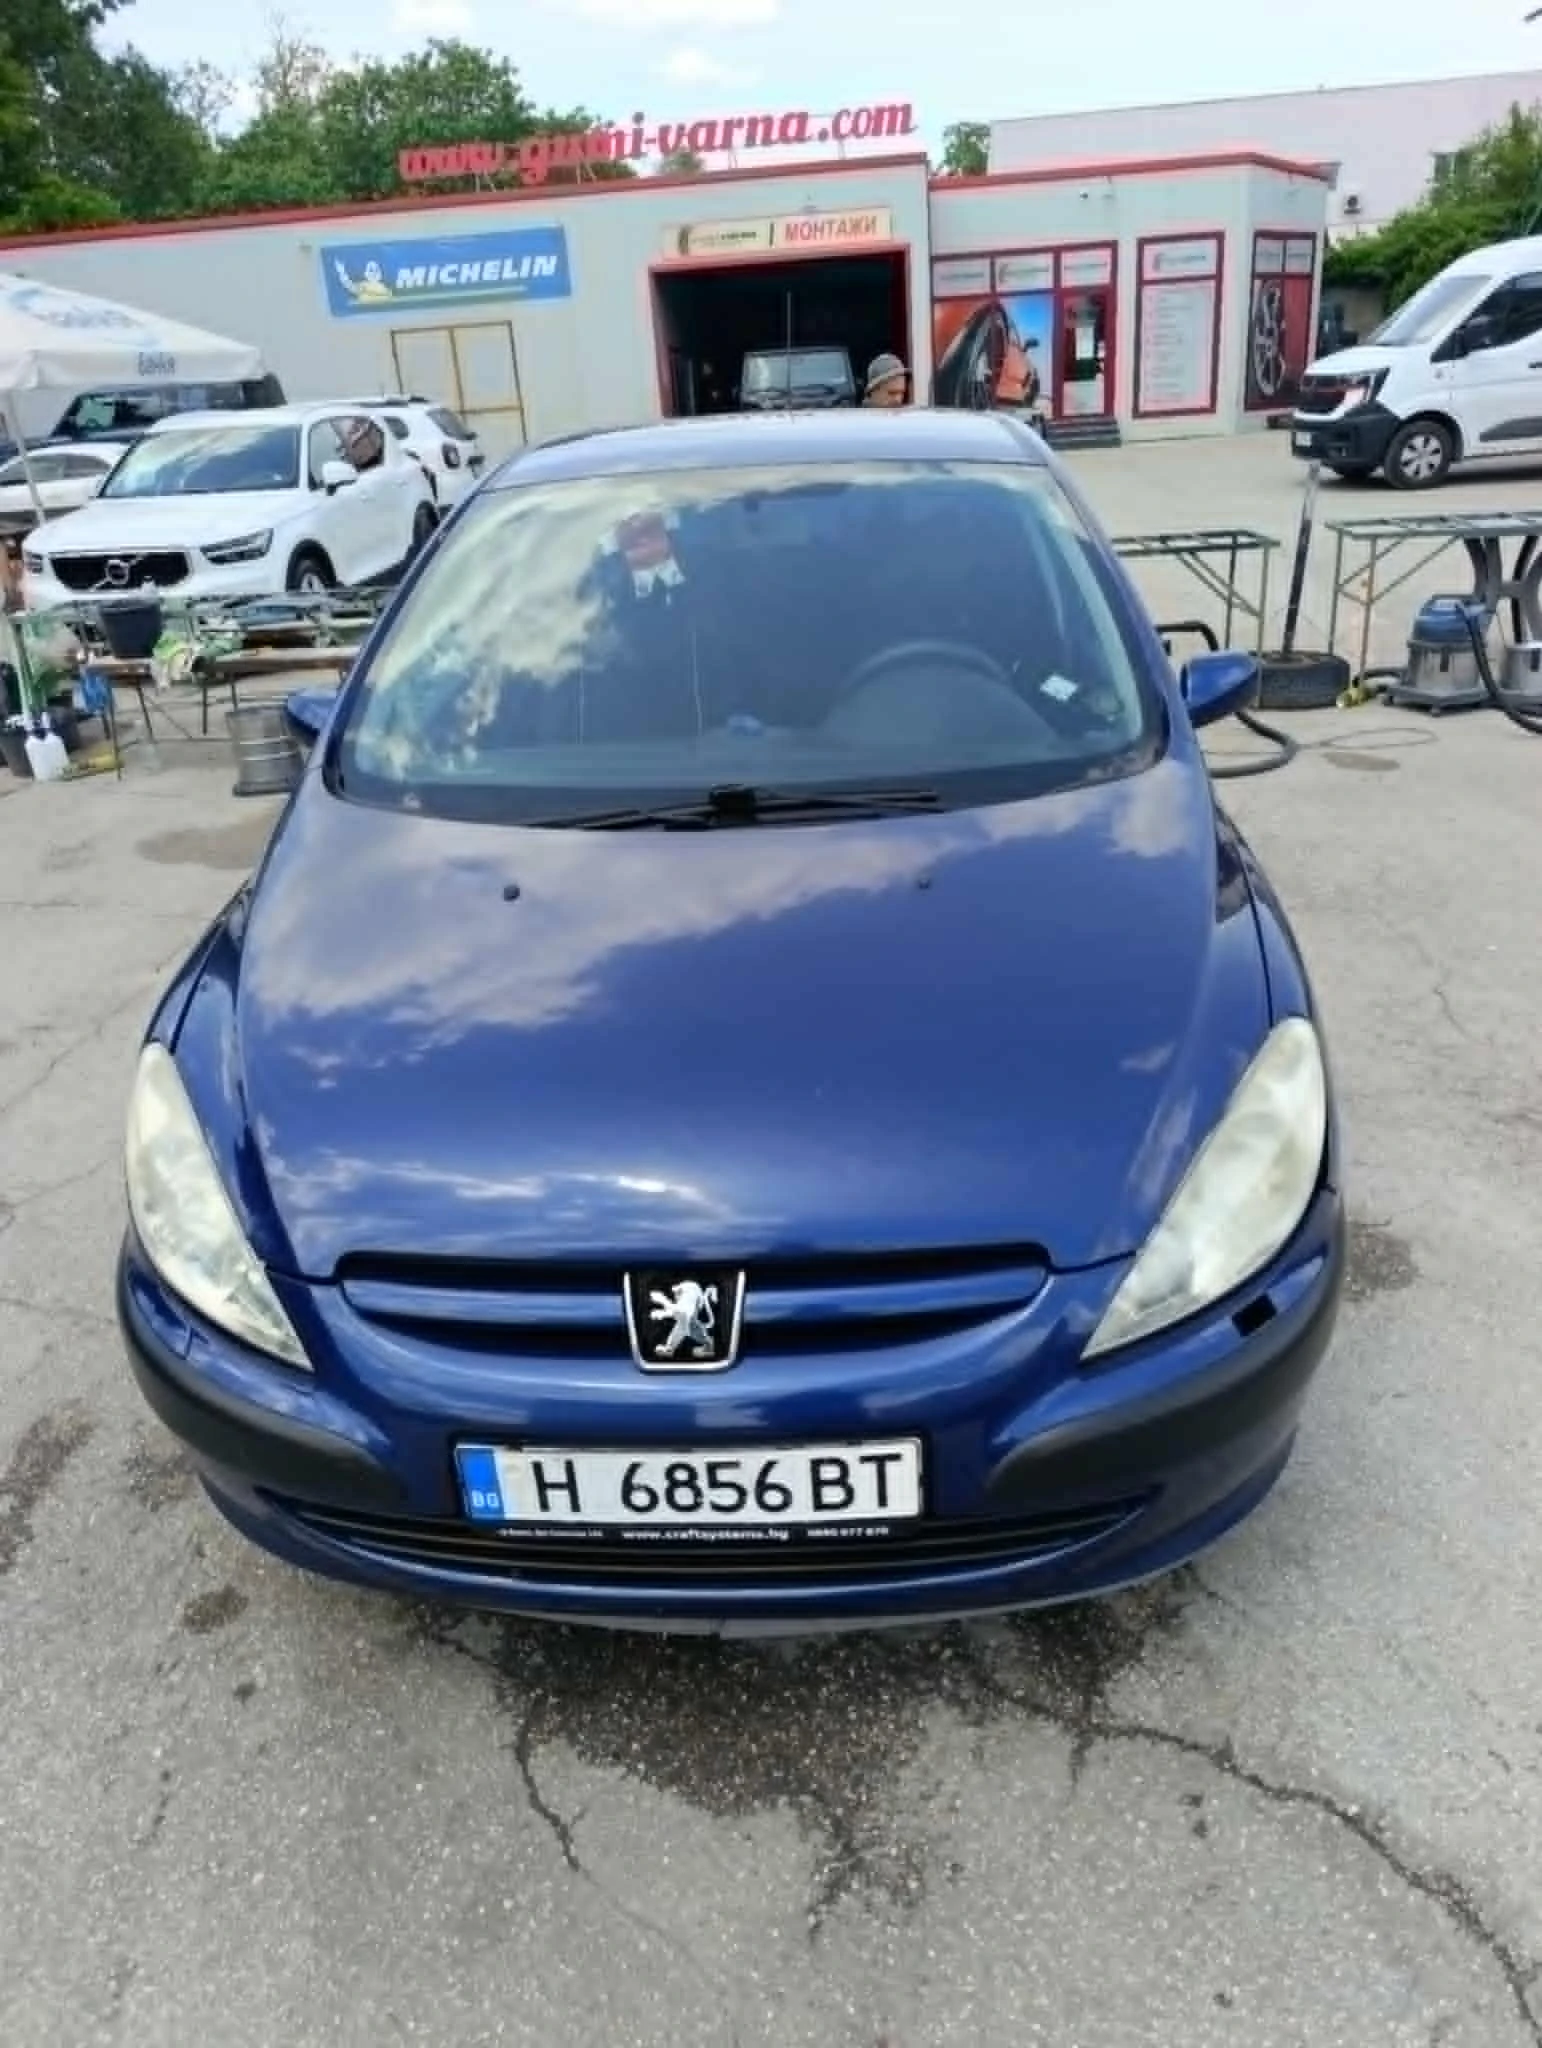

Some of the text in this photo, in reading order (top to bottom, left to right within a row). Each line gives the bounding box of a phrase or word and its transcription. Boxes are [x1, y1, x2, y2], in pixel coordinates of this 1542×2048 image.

[784, 214, 878, 242] МОНТАЖИ
[396, 255, 557, 289] MICHELIN
[471, 1490, 499, 1508] BG
[531, 1453, 902, 1514] H 6856 BT
